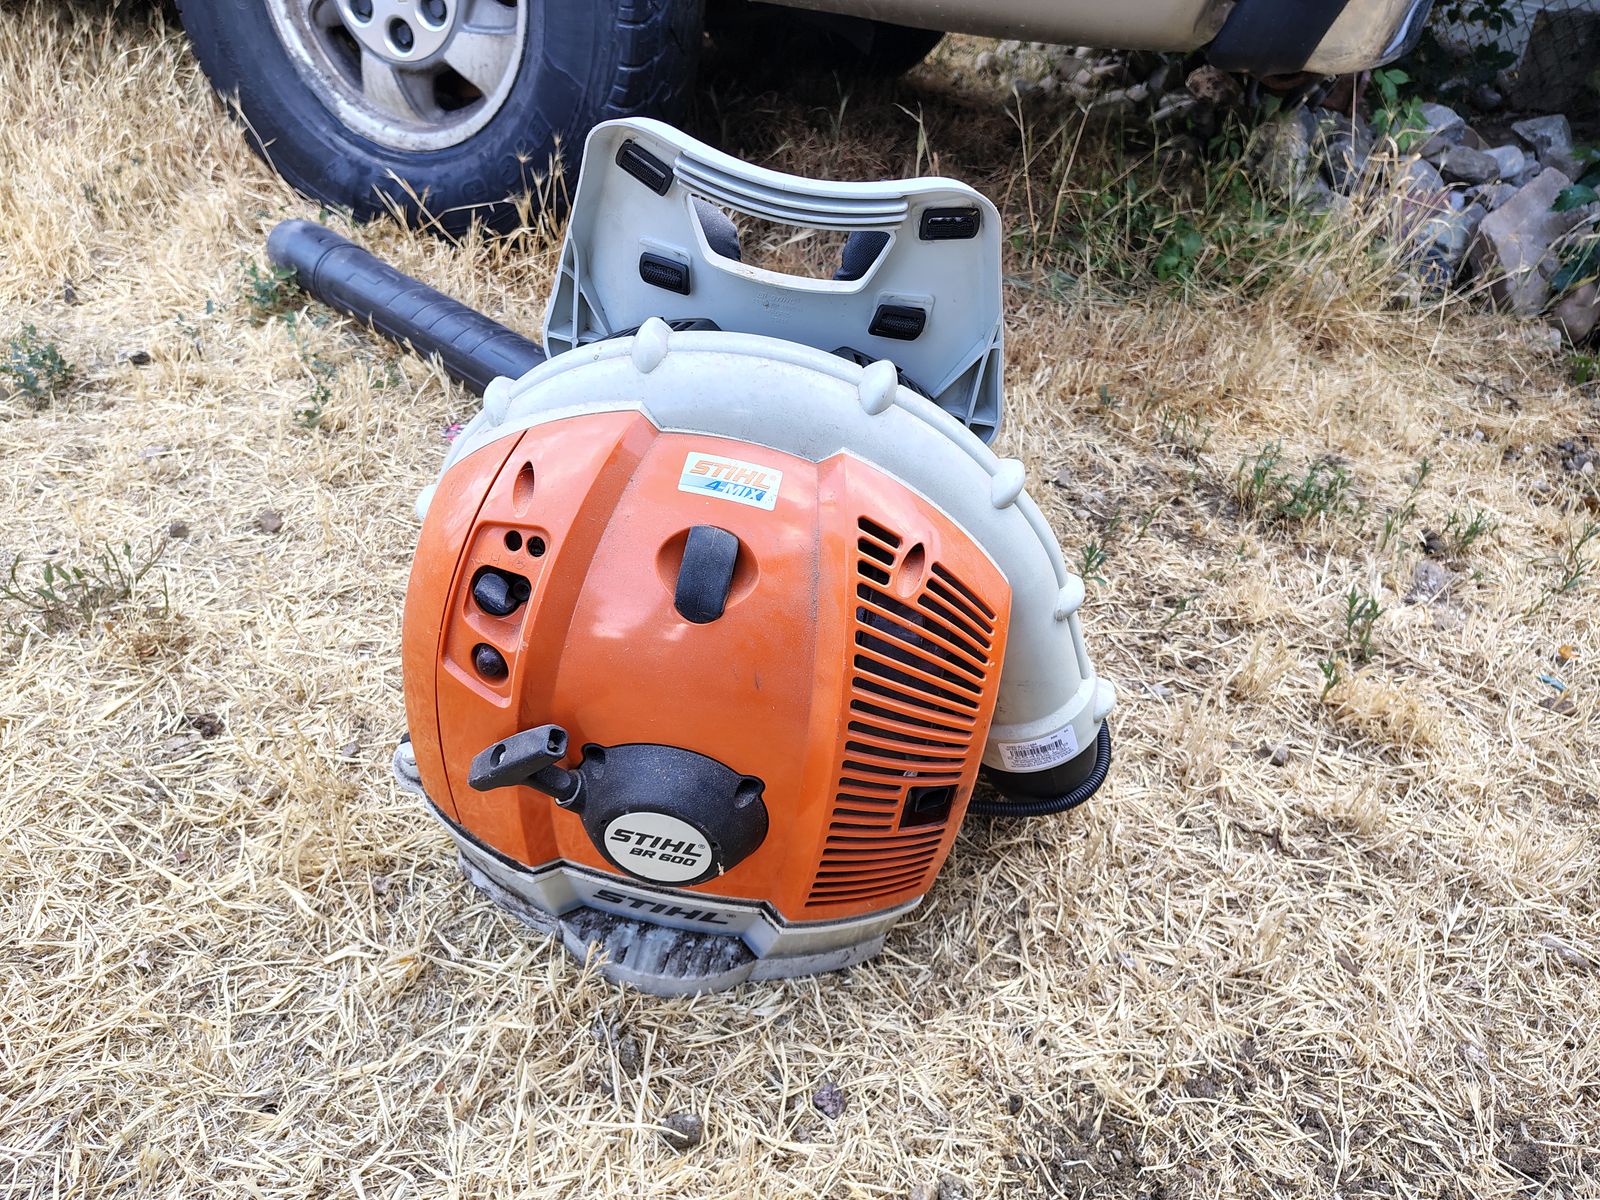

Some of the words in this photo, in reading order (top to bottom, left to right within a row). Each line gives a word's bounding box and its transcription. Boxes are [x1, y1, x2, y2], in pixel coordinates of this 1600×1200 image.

[705, 480, 766, 501] 4-MIX
[629, 847, 657, 859] BR
[658, 854, 697, 867] 600
